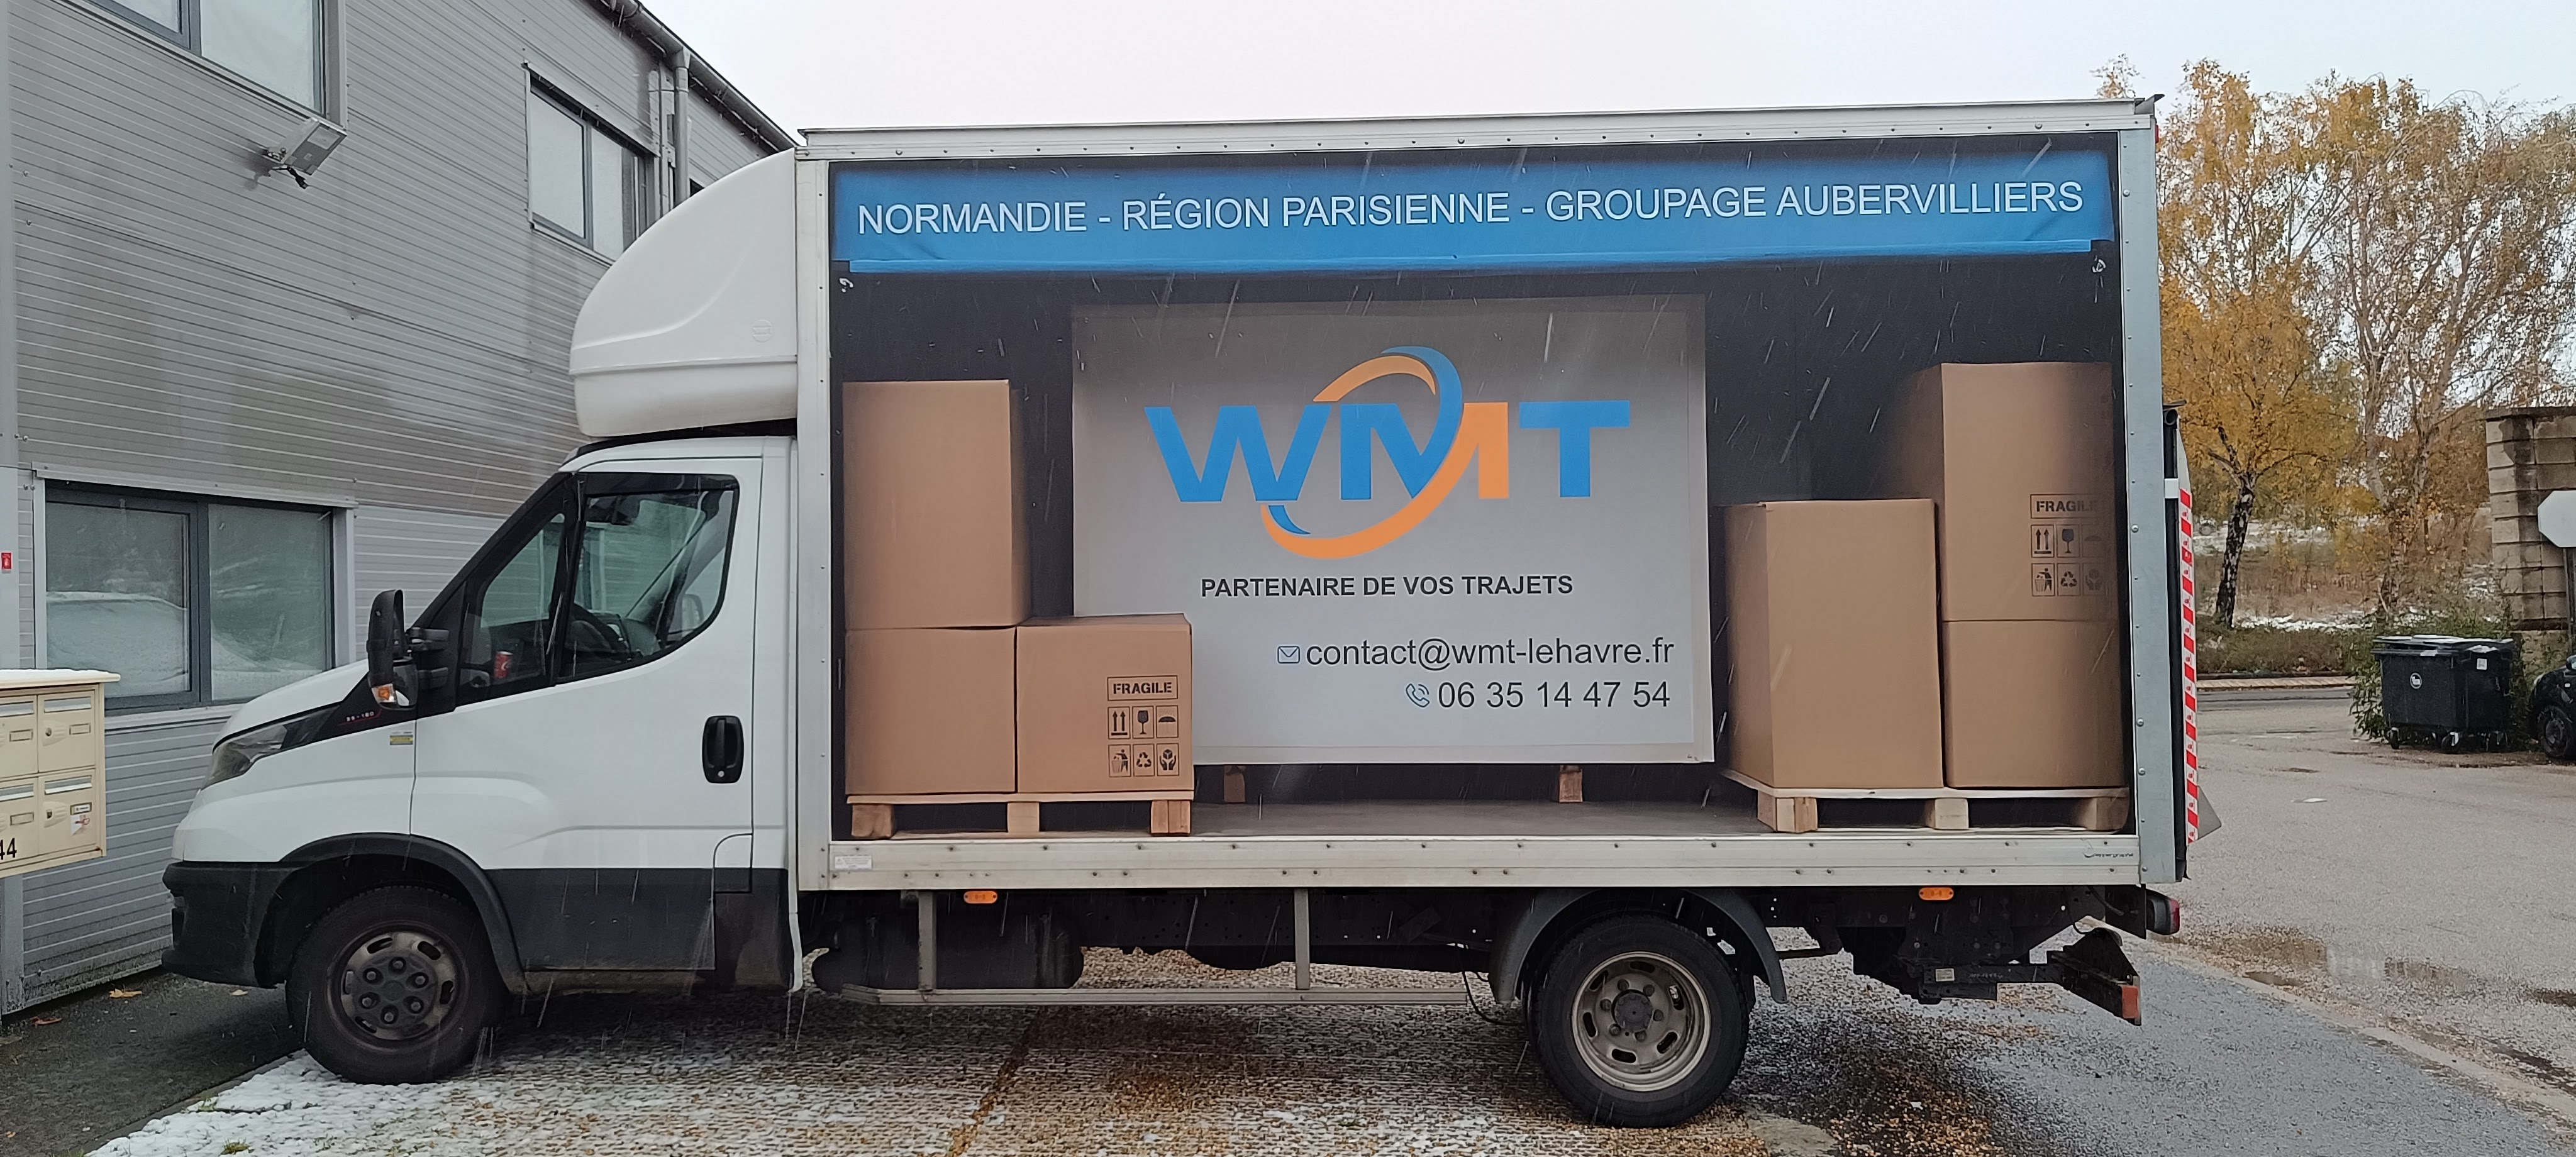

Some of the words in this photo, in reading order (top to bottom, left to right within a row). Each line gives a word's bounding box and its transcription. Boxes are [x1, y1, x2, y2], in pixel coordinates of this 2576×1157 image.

[858, 201, 1087, 235] NORMANDIE
[1123, 192, 1269, 231] RÉGION
[1282, 193, 1510, 227] PARISIENNE
[1546, 187, 1767, 221] GROUPAGE
[1775, 181, 2084, 217] AUBERVILLIERS
[1143, 399, 1630, 502] WMT
[1201, 577, 1356, 598] PARTENAIRE
[1363, 576, 1396, 596] DE
[1402, 575, 1454, 595] VOS
[1460, 574, 1574, 595] TRAJETS
[1306, 636, 1675, 672] contact@wmt-lehavre.fr
[1113, 682, 1172, 695] FRAGILE
[1438, 681, 1475, 709] 06
[1486, 681, 1524, 709] 35
[1536, 680, 1573, 708] 14
[1582, 680, 1621, 708] 47
[1633, 680, 1671, 708] 54
